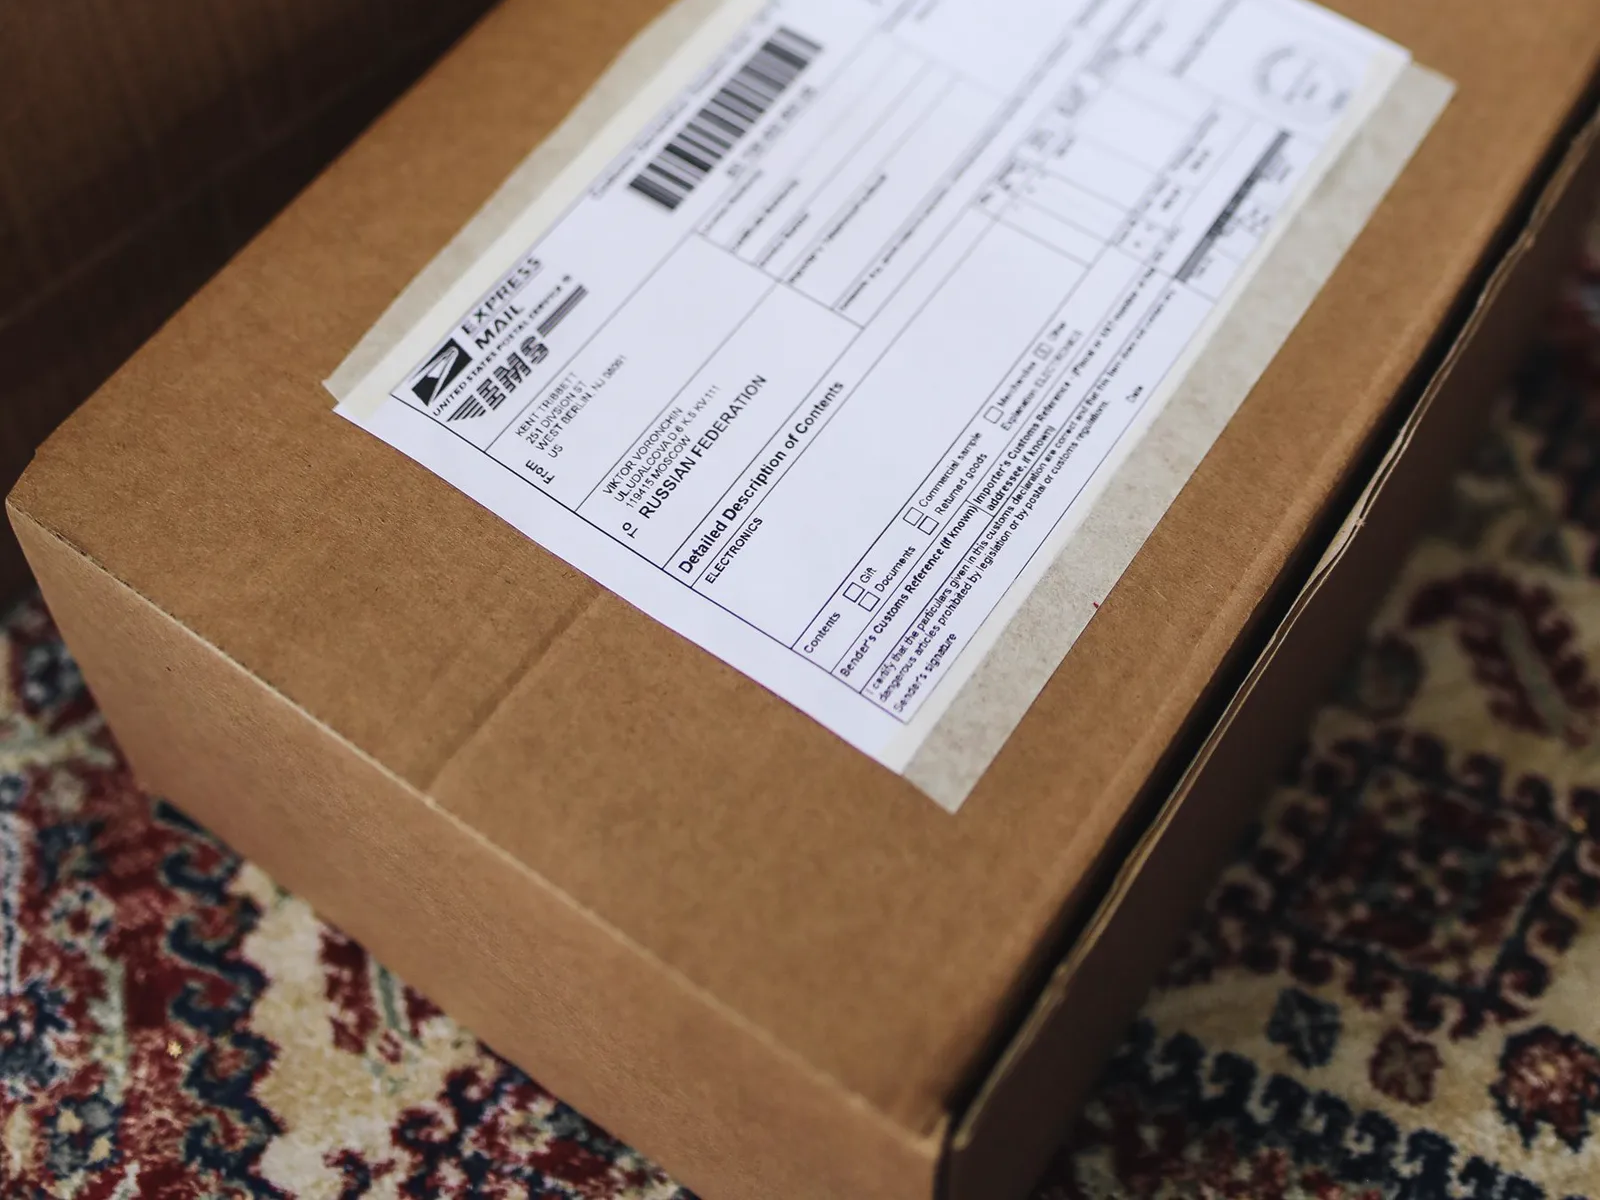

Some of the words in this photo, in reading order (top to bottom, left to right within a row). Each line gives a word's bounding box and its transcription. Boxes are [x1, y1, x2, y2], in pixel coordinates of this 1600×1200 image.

[460, 256, 541, 336] EXPRESS
[473, 303, 522, 350] MAIL
[432, 380, 468, 416] UNITED
[466, 350, 497, 382] STATES
[470, 335, 550, 410] EMS
[514, 412, 540, 436] KENT
[537, 372, 576, 412] TRIBBETT
[525, 427, 544, 444] 251
[540, 392, 576, 428] DIVSION
[572, 380, 587, 394] ST
[535, 422, 564, 450] WEST
[560, 390, 594, 424] BERLIN,
[972, 459, 1012, 504] Importer's
[1006, 422, 1040, 460] Customs
[1035, 381, 1070, 422] Reference
[524, 460, 555, 484] From
[548, 444, 564, 458] US
[602, 460, 637, 494] VIKTOR
[632, 406, 683, 460] VORONCHIN
[614, 439, 672, 502] UL.UDALCOVA
[626, 478, 654, 508] 119415
[650, 434, 691, 480] MOSCOW
[638, 456, 696, 519] RUSSIAN
[690, 374, 766, 458] FEDERATION
[678, 520, 728, 574] Detailed
[722, 449, 788, 521] Description
[782, 432, 800, 450] of
[794, 380, 844, 434] Contents
[918, 460, 960, 508] Commercial
[956, 432, 982, 461] sample
[986, 464, 1028, 511] addressee,
[1026, 424, 1056, 456] known)
[934, 477, 968, 516] Returned
[964, 452, 988, 480] goods
[620, 521, 639, 538] To
[704, 516, 764, 584] ELECTRONICS
[870, 661, 896, 690] certify
[890, 643, 908, 662] that
[902, 628, 919, 645] the
[915, 584, 952, 632] particulars
[948, 564, 970, 588] given
[971, 538, 988, 556] this
[985, 505, 1015, 540] customs
[1008, 460, 1048, 505] declaration
[1044, 448, 1056, 462] are
[1054, 420, 1078, 448] correct
[859, 566, 876, 584] Gift
[872, 592, 910, 634] Customs
[904, 546, 945, 594] Reference
[946, 504, 979, 540] known)
[874, 545, 916, 592] Documents
[878, 656, 918, 702] dangerous
[913, 624, 940, 656] articles
[936, 580, 972, 626] prohibited
[966, 570, 982, 584] by
[974, 529, 1012, 572] legislation
[1008, 519, 1020, 530] or
[1014, 508, 1028, 520] by
[1022, 482, 1046, 510] postal
[1050, 442, 1078, 474] customs
[802, 611, 840, 654] Contents
[892, 672, 928, 712] Sender's
[923, 632, 957, 673] signature
